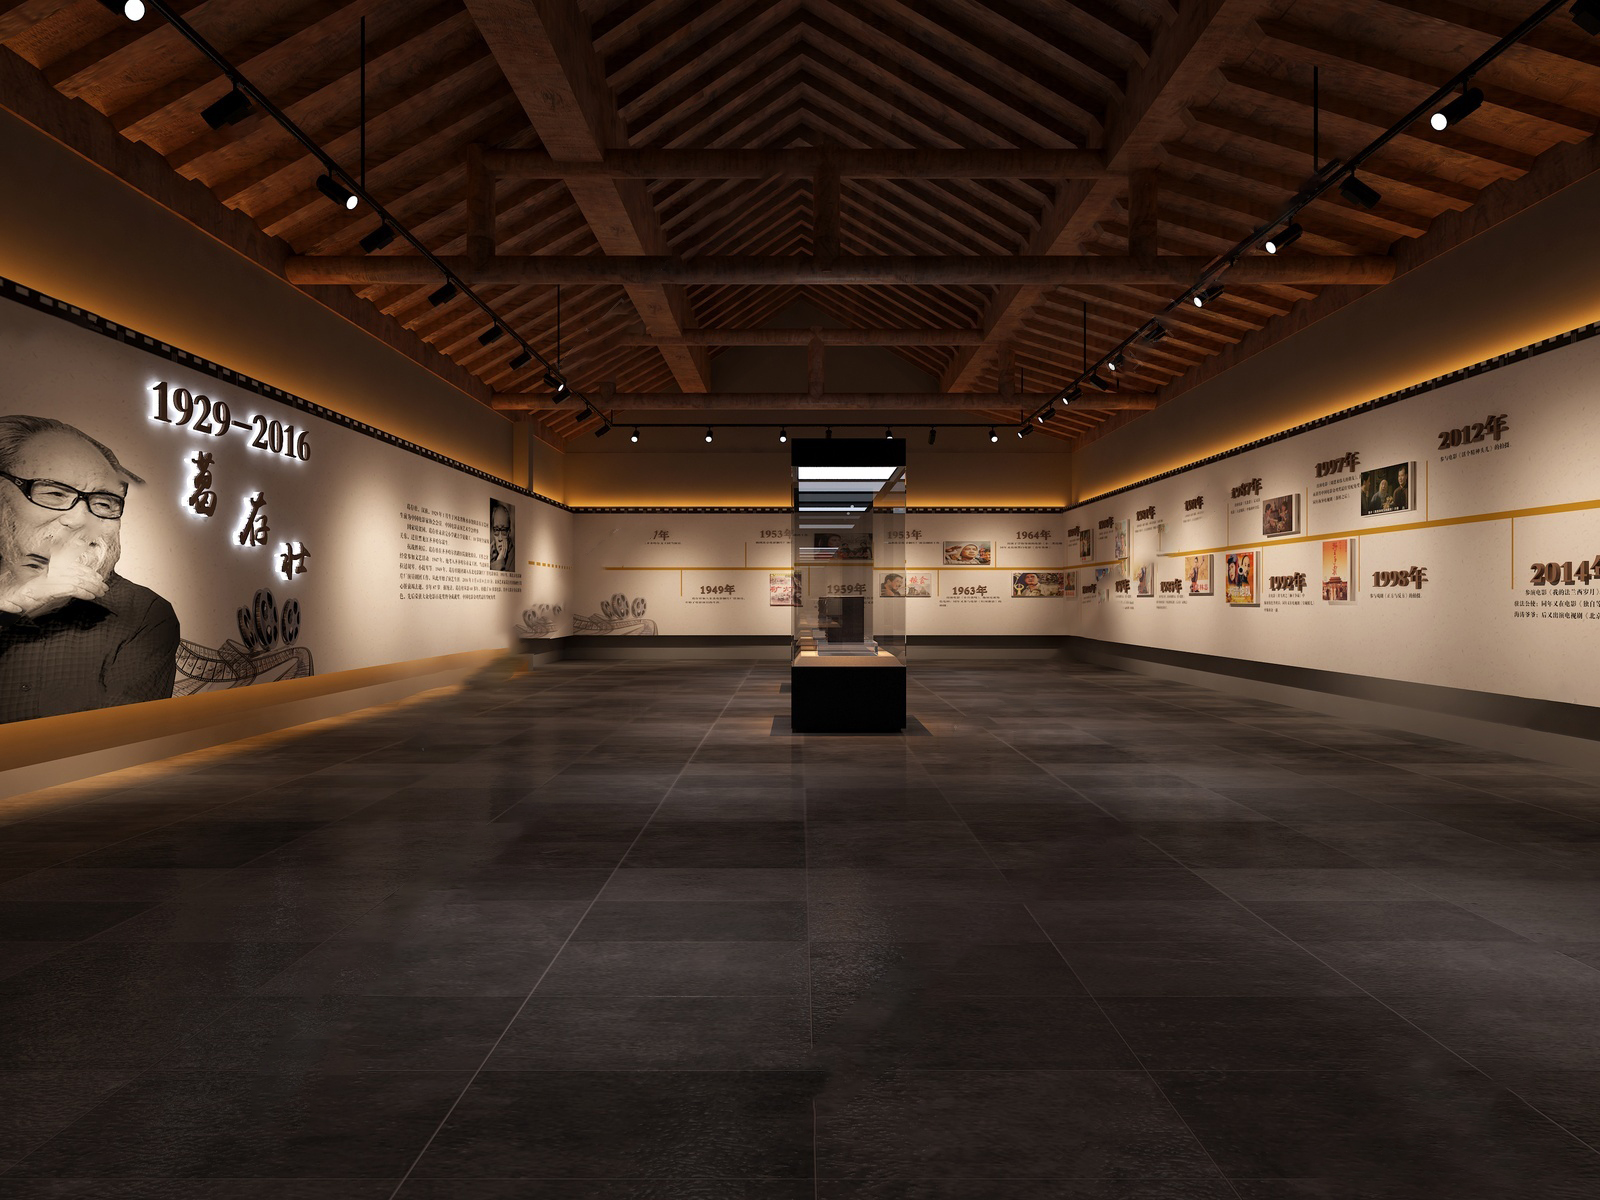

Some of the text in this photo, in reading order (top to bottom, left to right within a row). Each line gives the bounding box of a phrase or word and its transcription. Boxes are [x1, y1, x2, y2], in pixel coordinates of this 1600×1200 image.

[1438, 414, 1510, 450] 2012年
[1315, 451, 1361, 478] 1997年
[1016, 529, 1051, 541] 1964年
[1372, 566, 1429, 590] 1998年
[700, 584, 736, 596] 1949年
[827, 583, 867, 595] 1959年
[952, 584, 988, 597] 1963年
